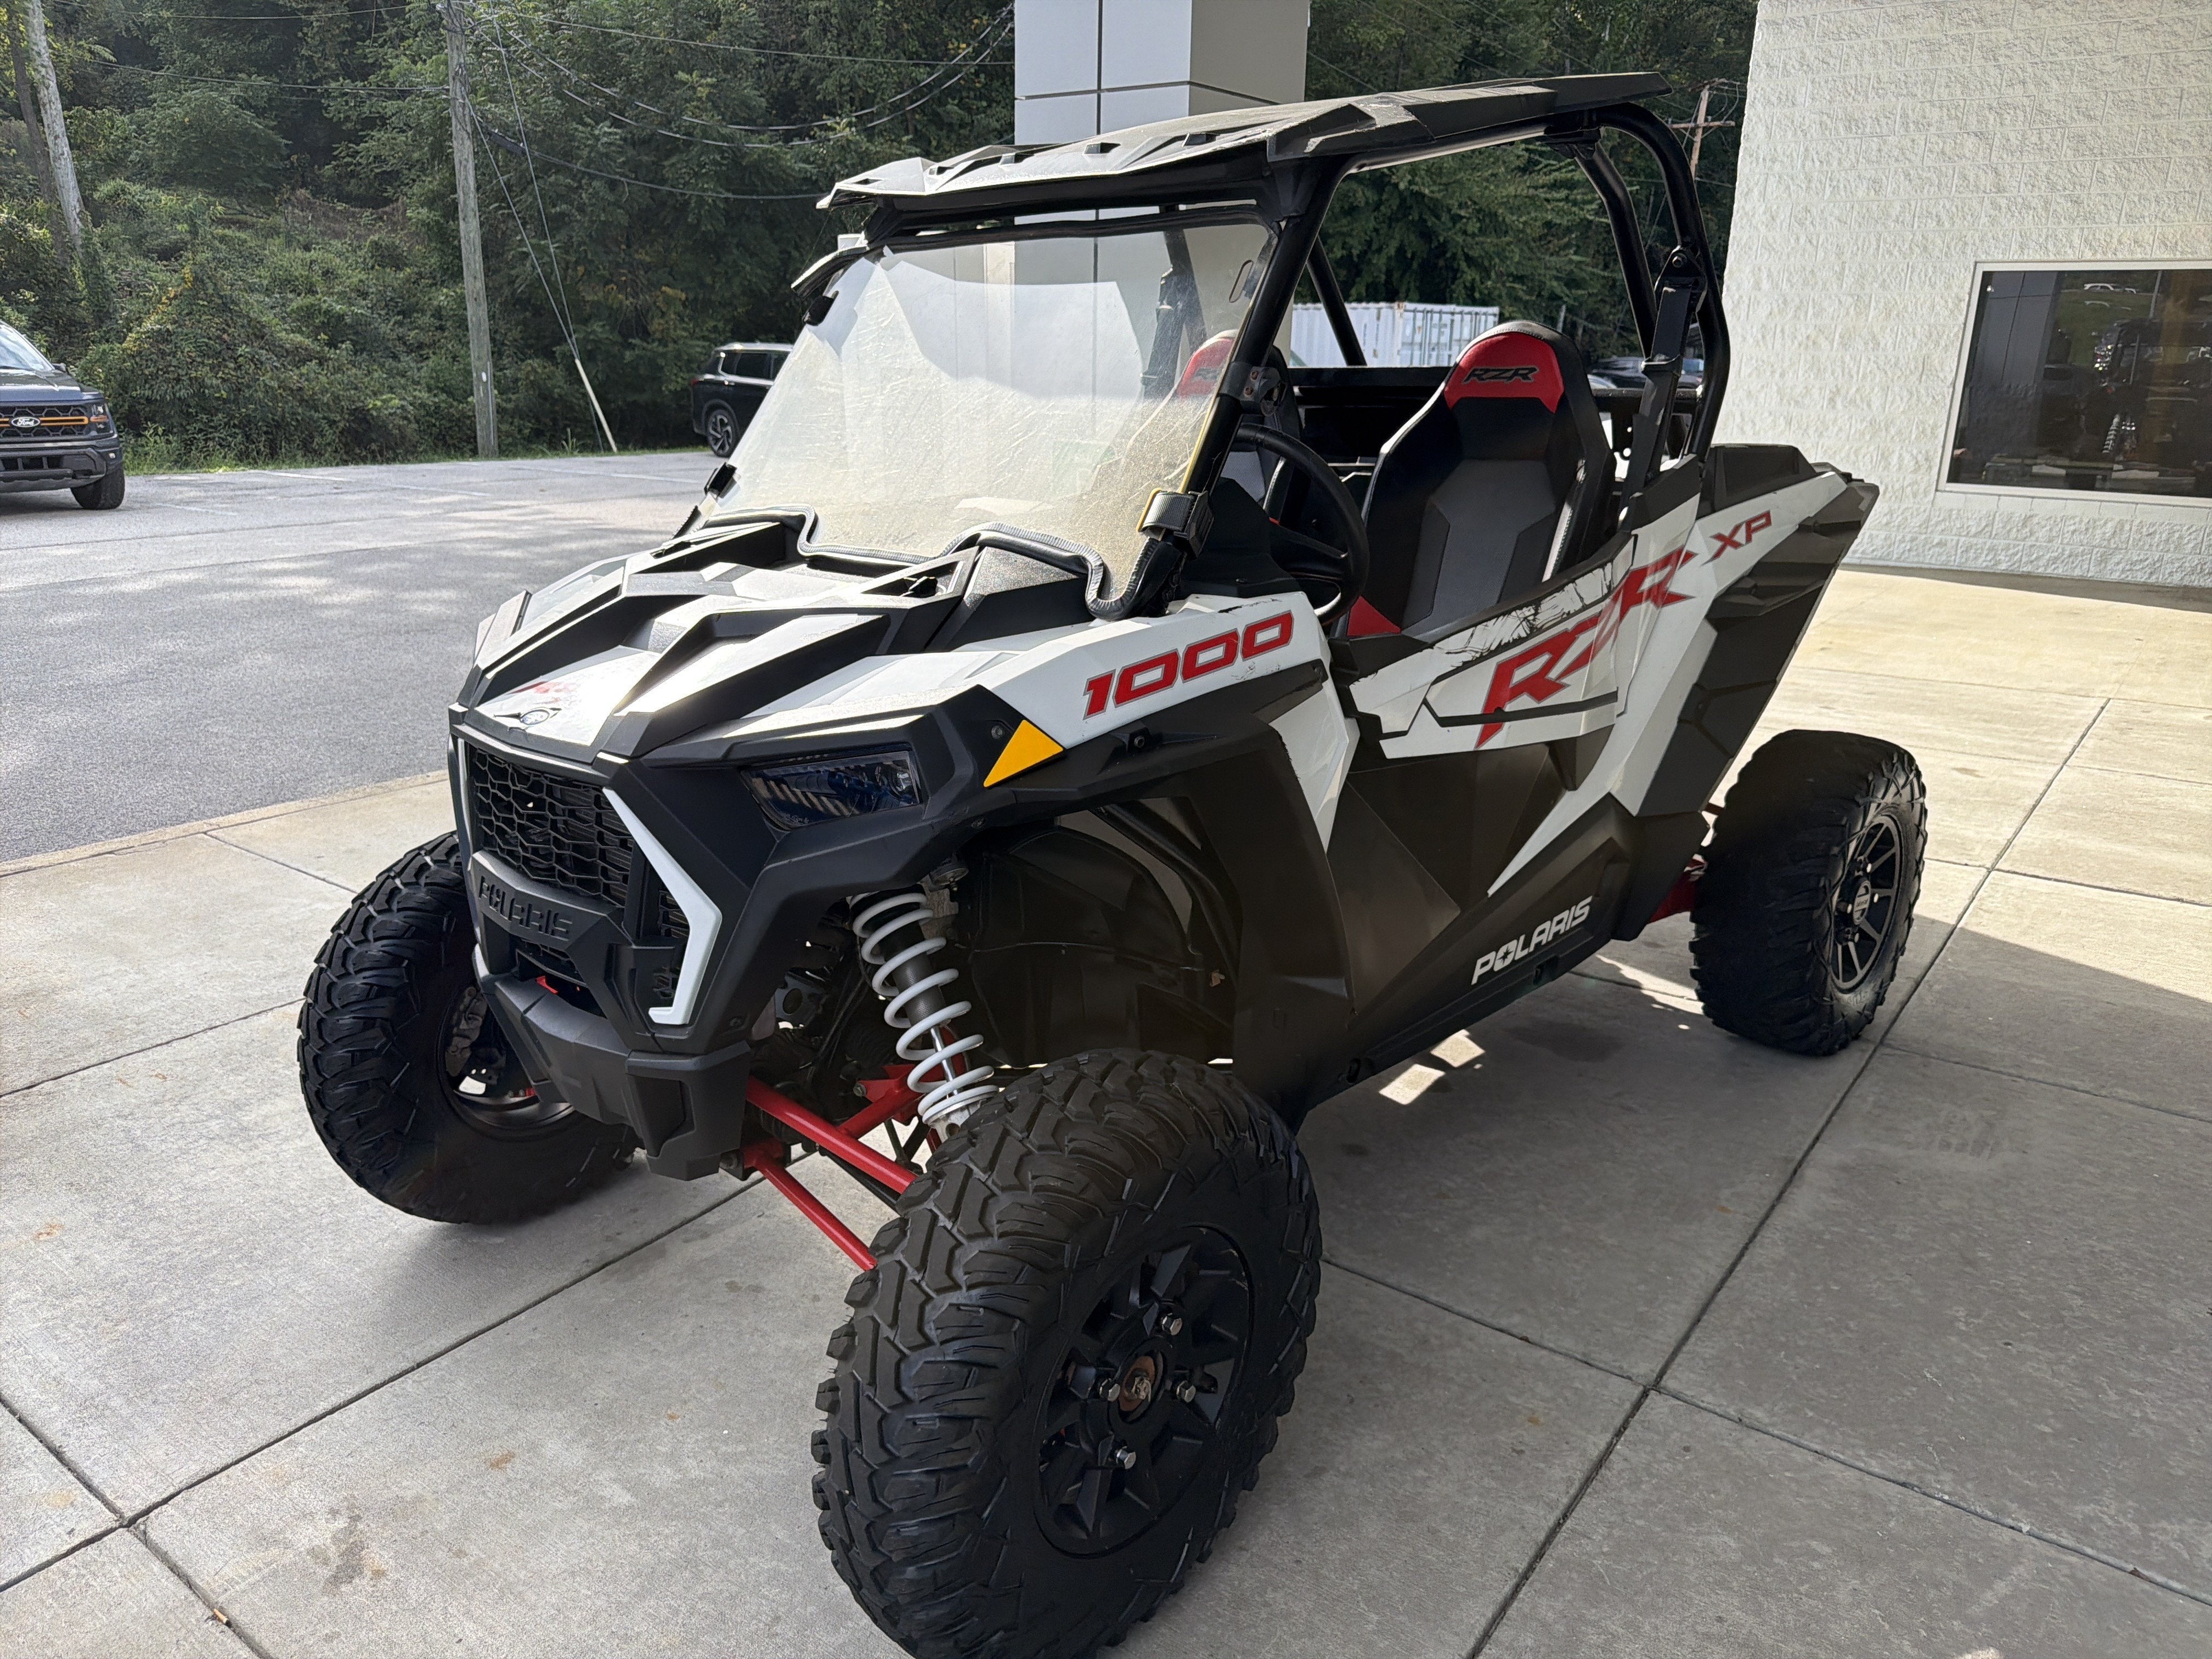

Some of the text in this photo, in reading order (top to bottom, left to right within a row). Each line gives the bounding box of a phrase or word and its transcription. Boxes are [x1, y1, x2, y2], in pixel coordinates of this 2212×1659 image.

[1462, 366, 1539, 383] RZR
[1083, 610, 1294, 720] 1000
[1475, 510, 1773, 748] RZR XP
[479, 876, 573, 941] POLARIS
[1471, 895, 1593, 985] POLARIS
